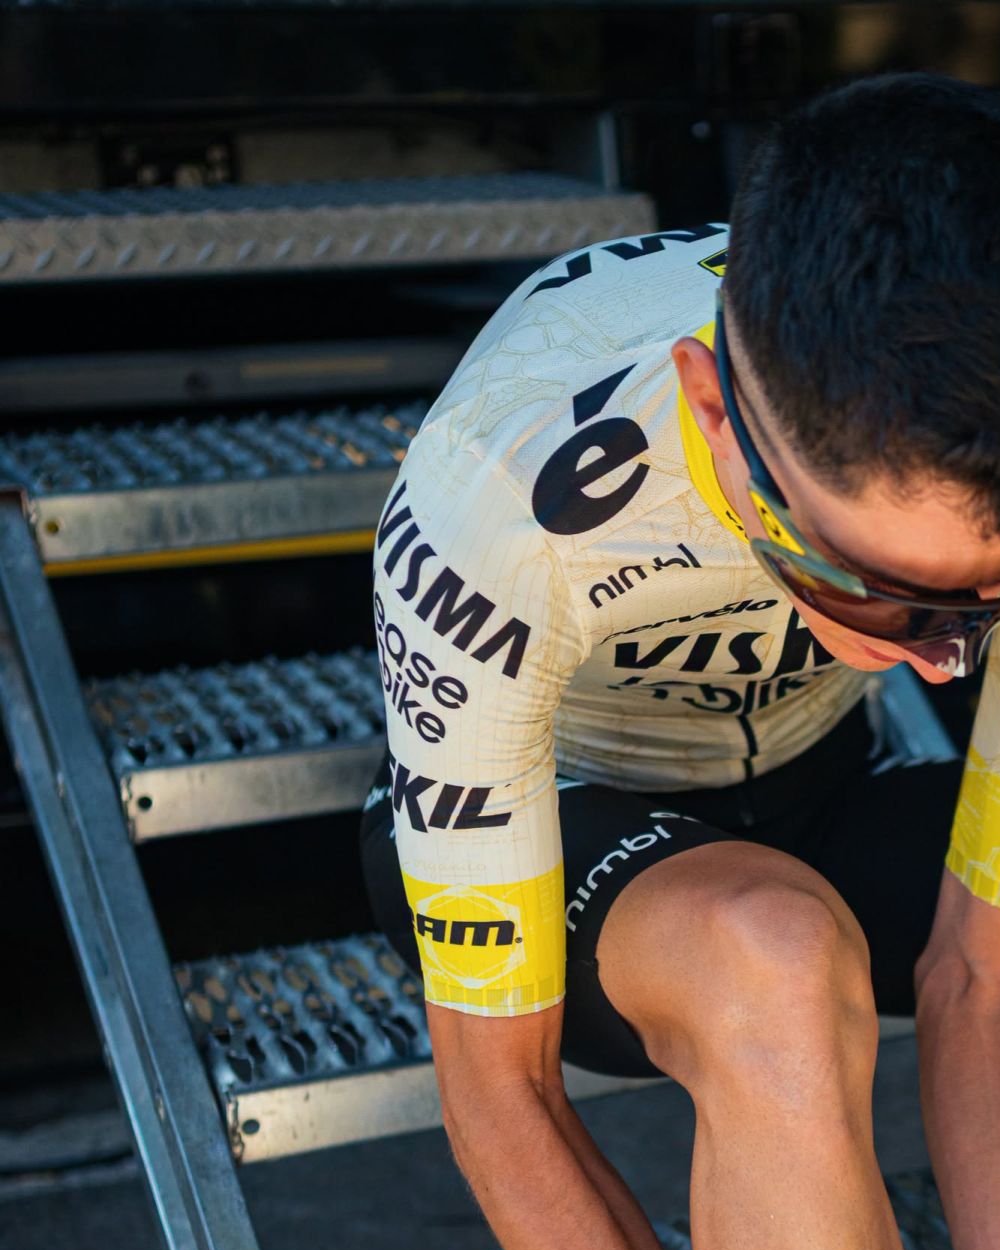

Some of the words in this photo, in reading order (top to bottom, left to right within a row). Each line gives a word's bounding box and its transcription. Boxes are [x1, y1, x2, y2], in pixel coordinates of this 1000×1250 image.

[377, 479, 532, 680] VISMA
[374, 590, 469, 710] ease
[390, 760, 512, 833] KIL
[565, 824, 672, 933] nimbl
